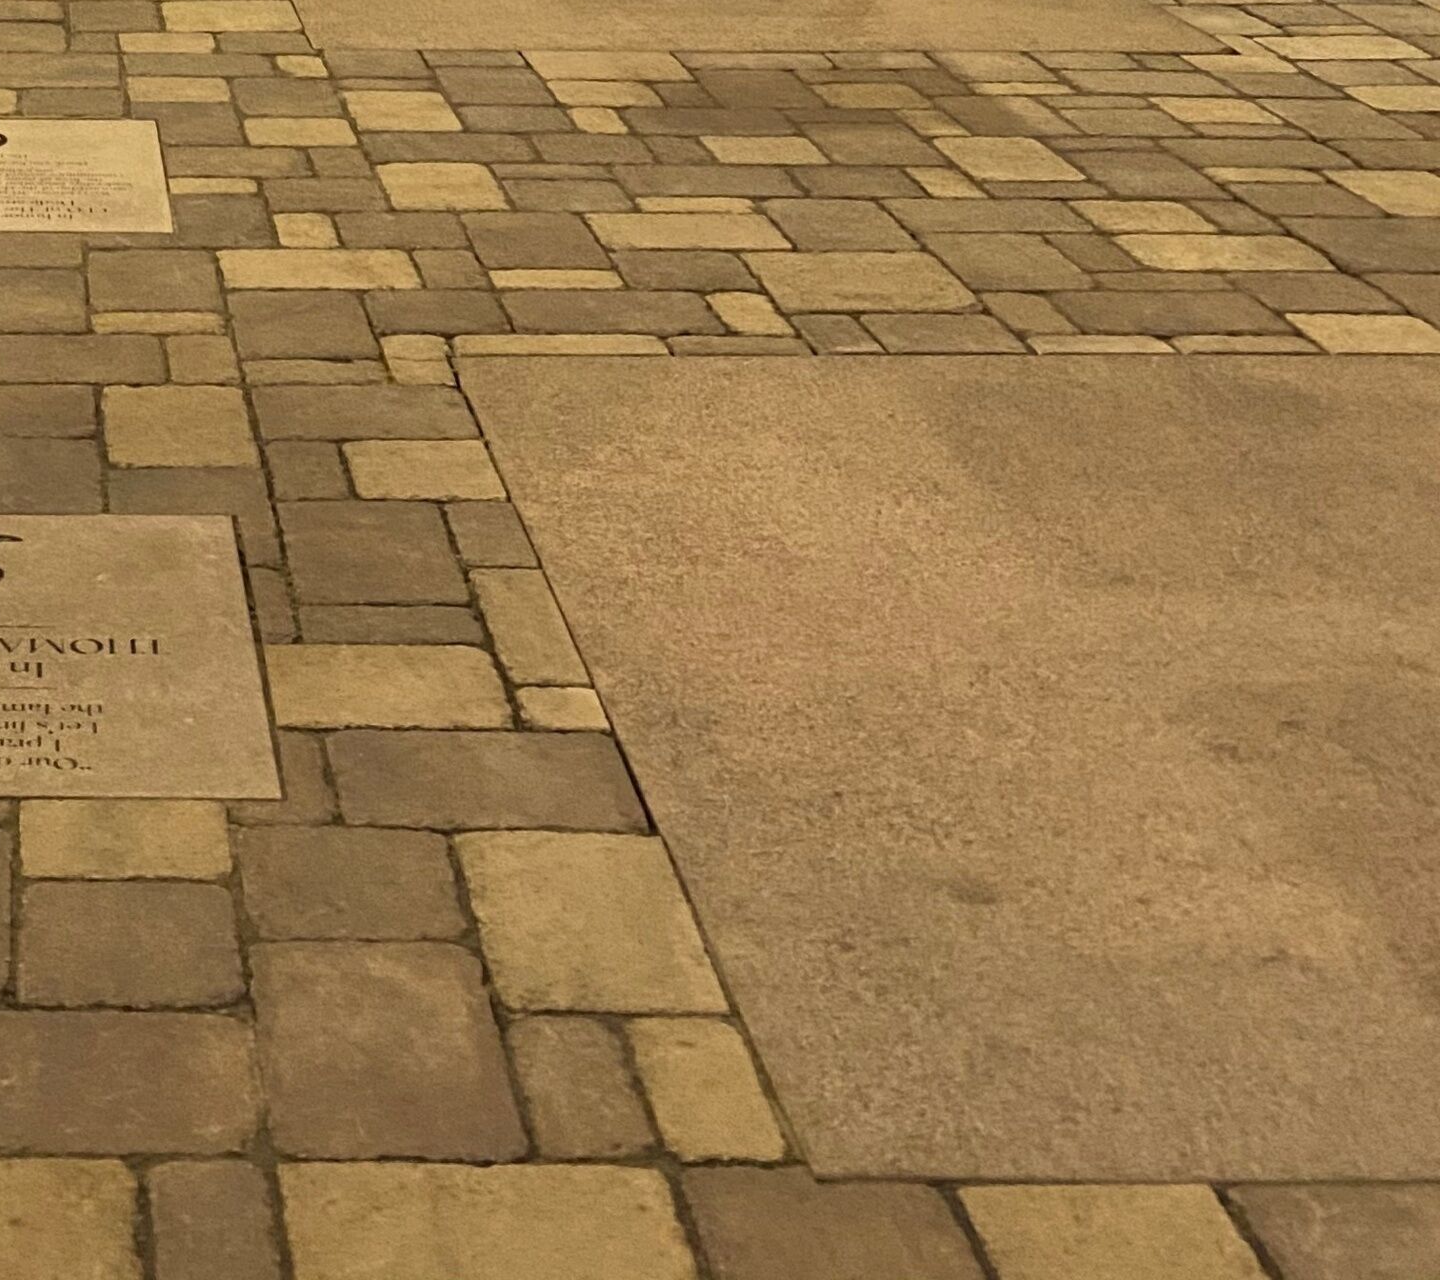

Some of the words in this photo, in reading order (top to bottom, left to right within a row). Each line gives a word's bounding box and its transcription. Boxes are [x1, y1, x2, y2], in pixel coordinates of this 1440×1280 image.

[9, 662, 44, 678] In
[60, 704, 104, 716] the
[54, 739, 61, 751] I
